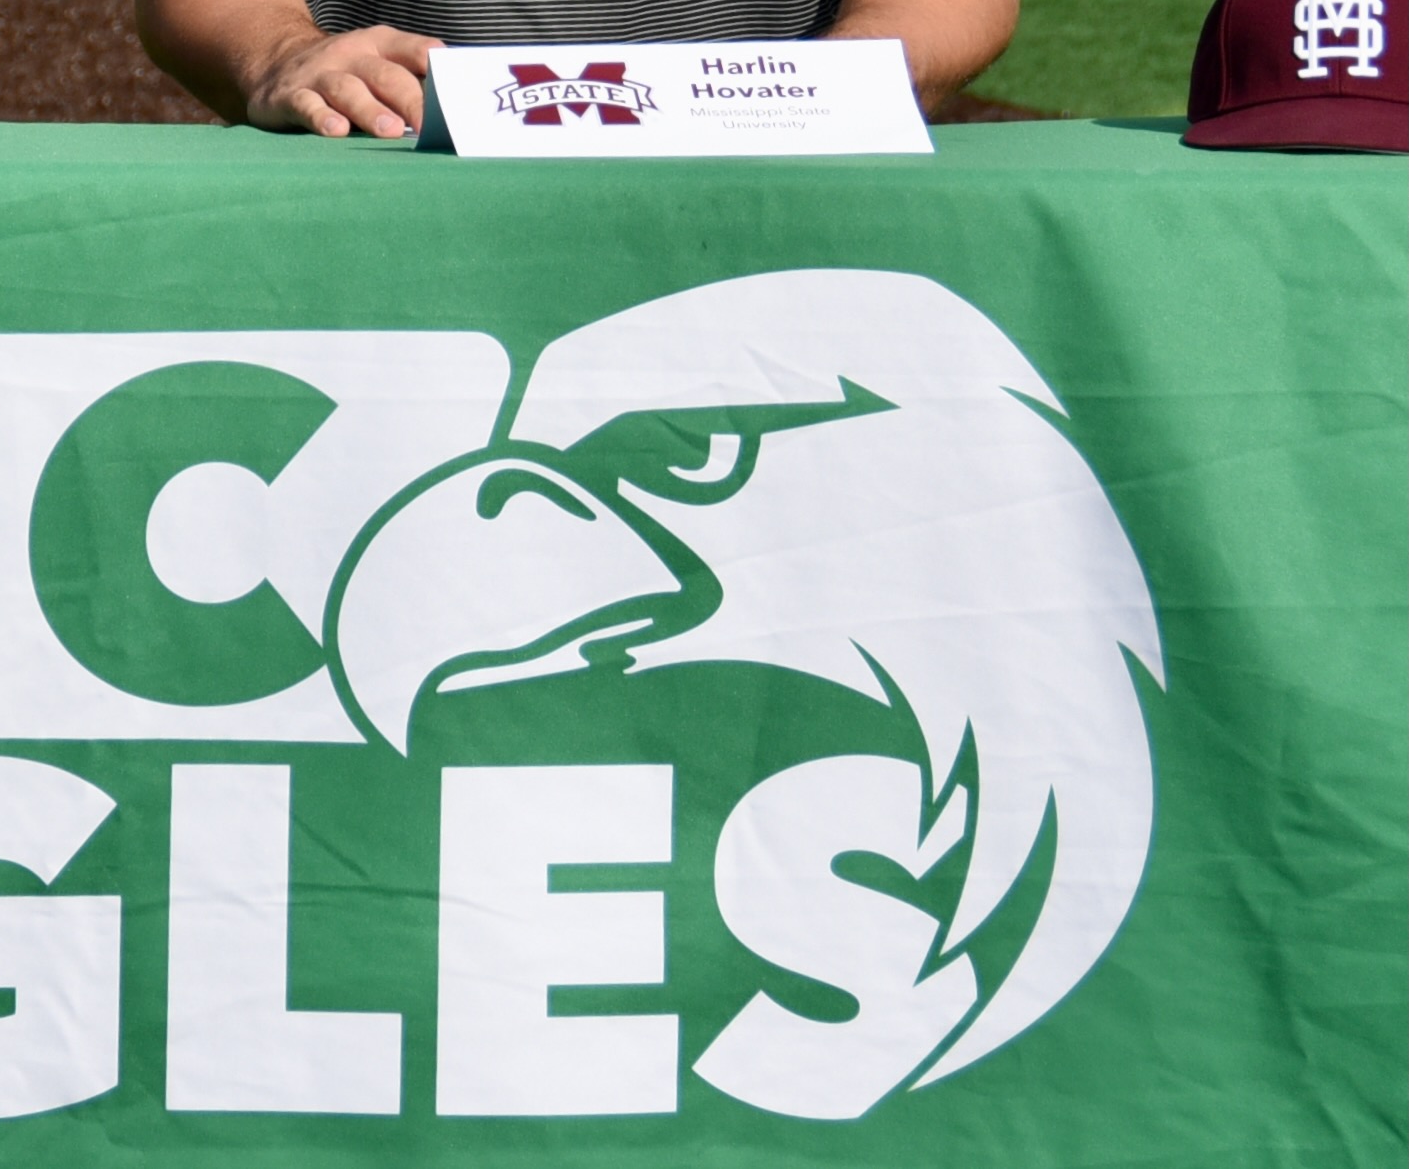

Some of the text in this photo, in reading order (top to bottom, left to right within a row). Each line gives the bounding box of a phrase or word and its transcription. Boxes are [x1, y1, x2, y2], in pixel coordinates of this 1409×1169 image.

[700, 55, 797, 75] Harlin
[522, 84, 627, 105] STATE
[690, 83, 818, 99] Hovater
[690, 106, 831, 118] Mississippi State
[722, 120, 807, 130] University
